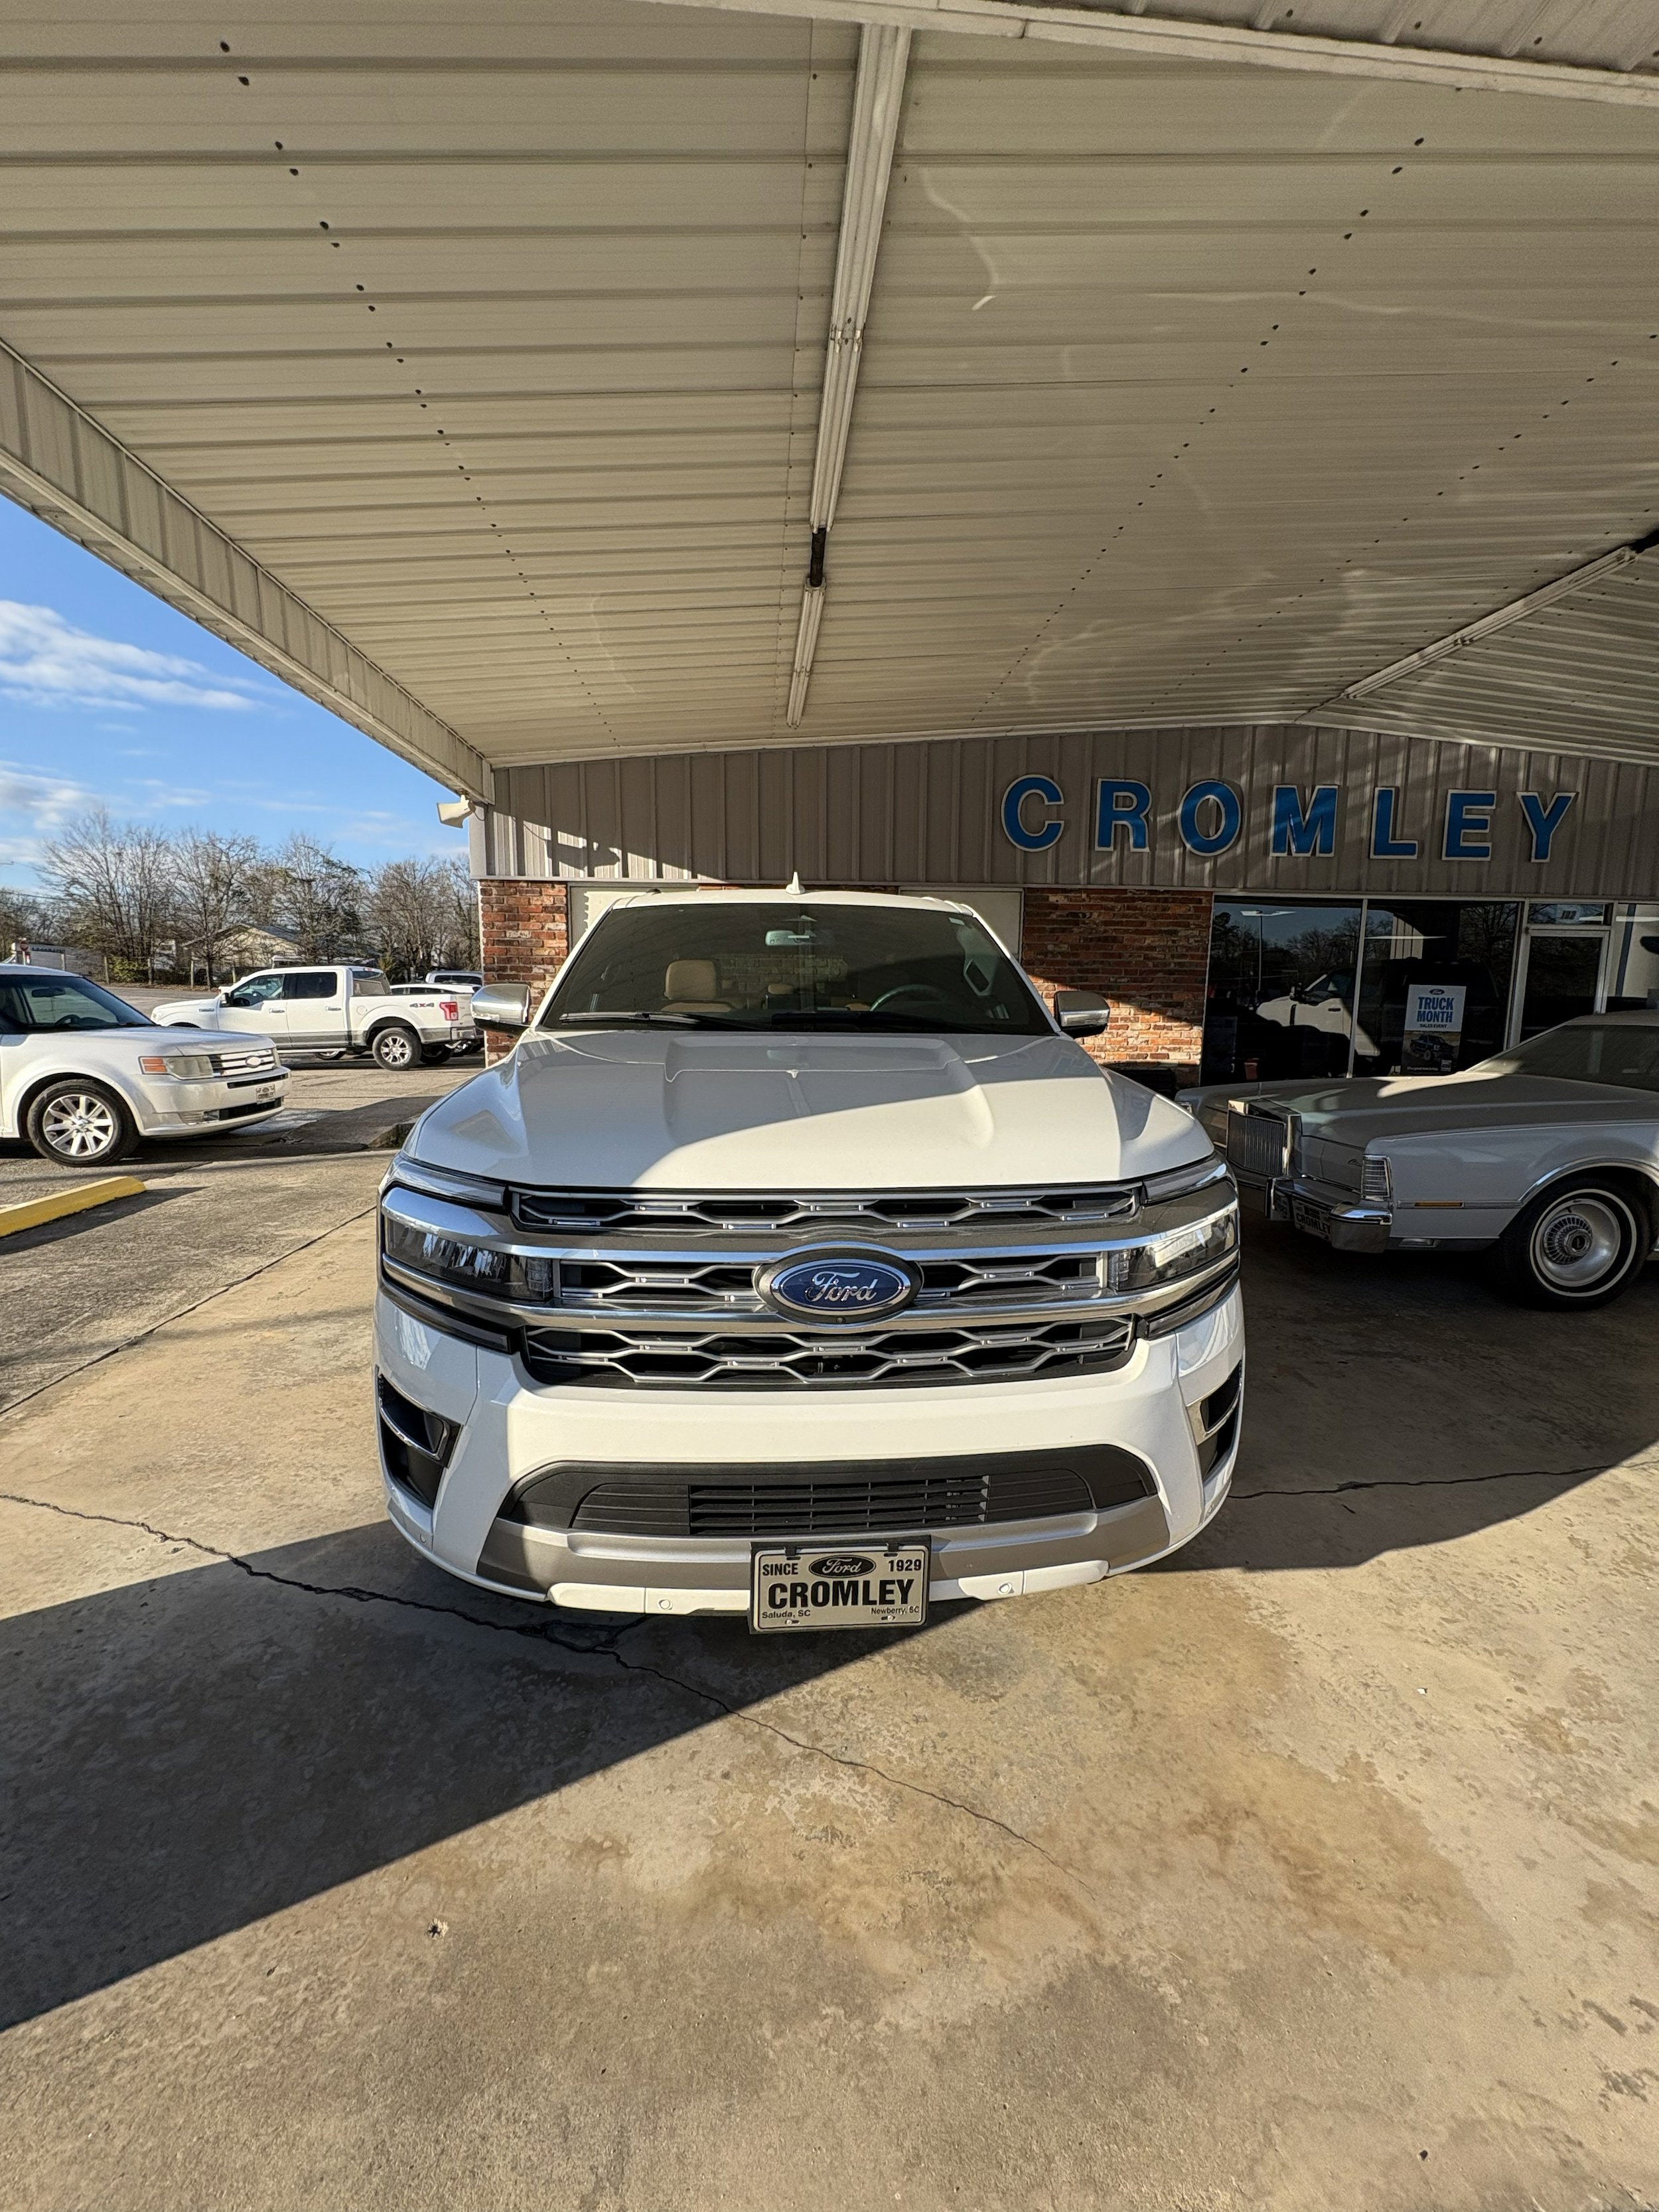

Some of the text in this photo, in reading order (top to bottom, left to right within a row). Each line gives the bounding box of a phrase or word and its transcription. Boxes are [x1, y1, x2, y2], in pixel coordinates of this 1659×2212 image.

[1001, 774, 1577, 863] CROMLEY
[1418, 997, 1454, 1010] TRUCK
[1417, 1010, 1453, 1023] MONTH
[805, 1271, 879, 1301] Ford
[762, 1558, 922, 1576] SINCE Ford 1929
[768, 1578, 914, 1609] CROMLEY
[762, 1610, 796, 1619] Saluda,
